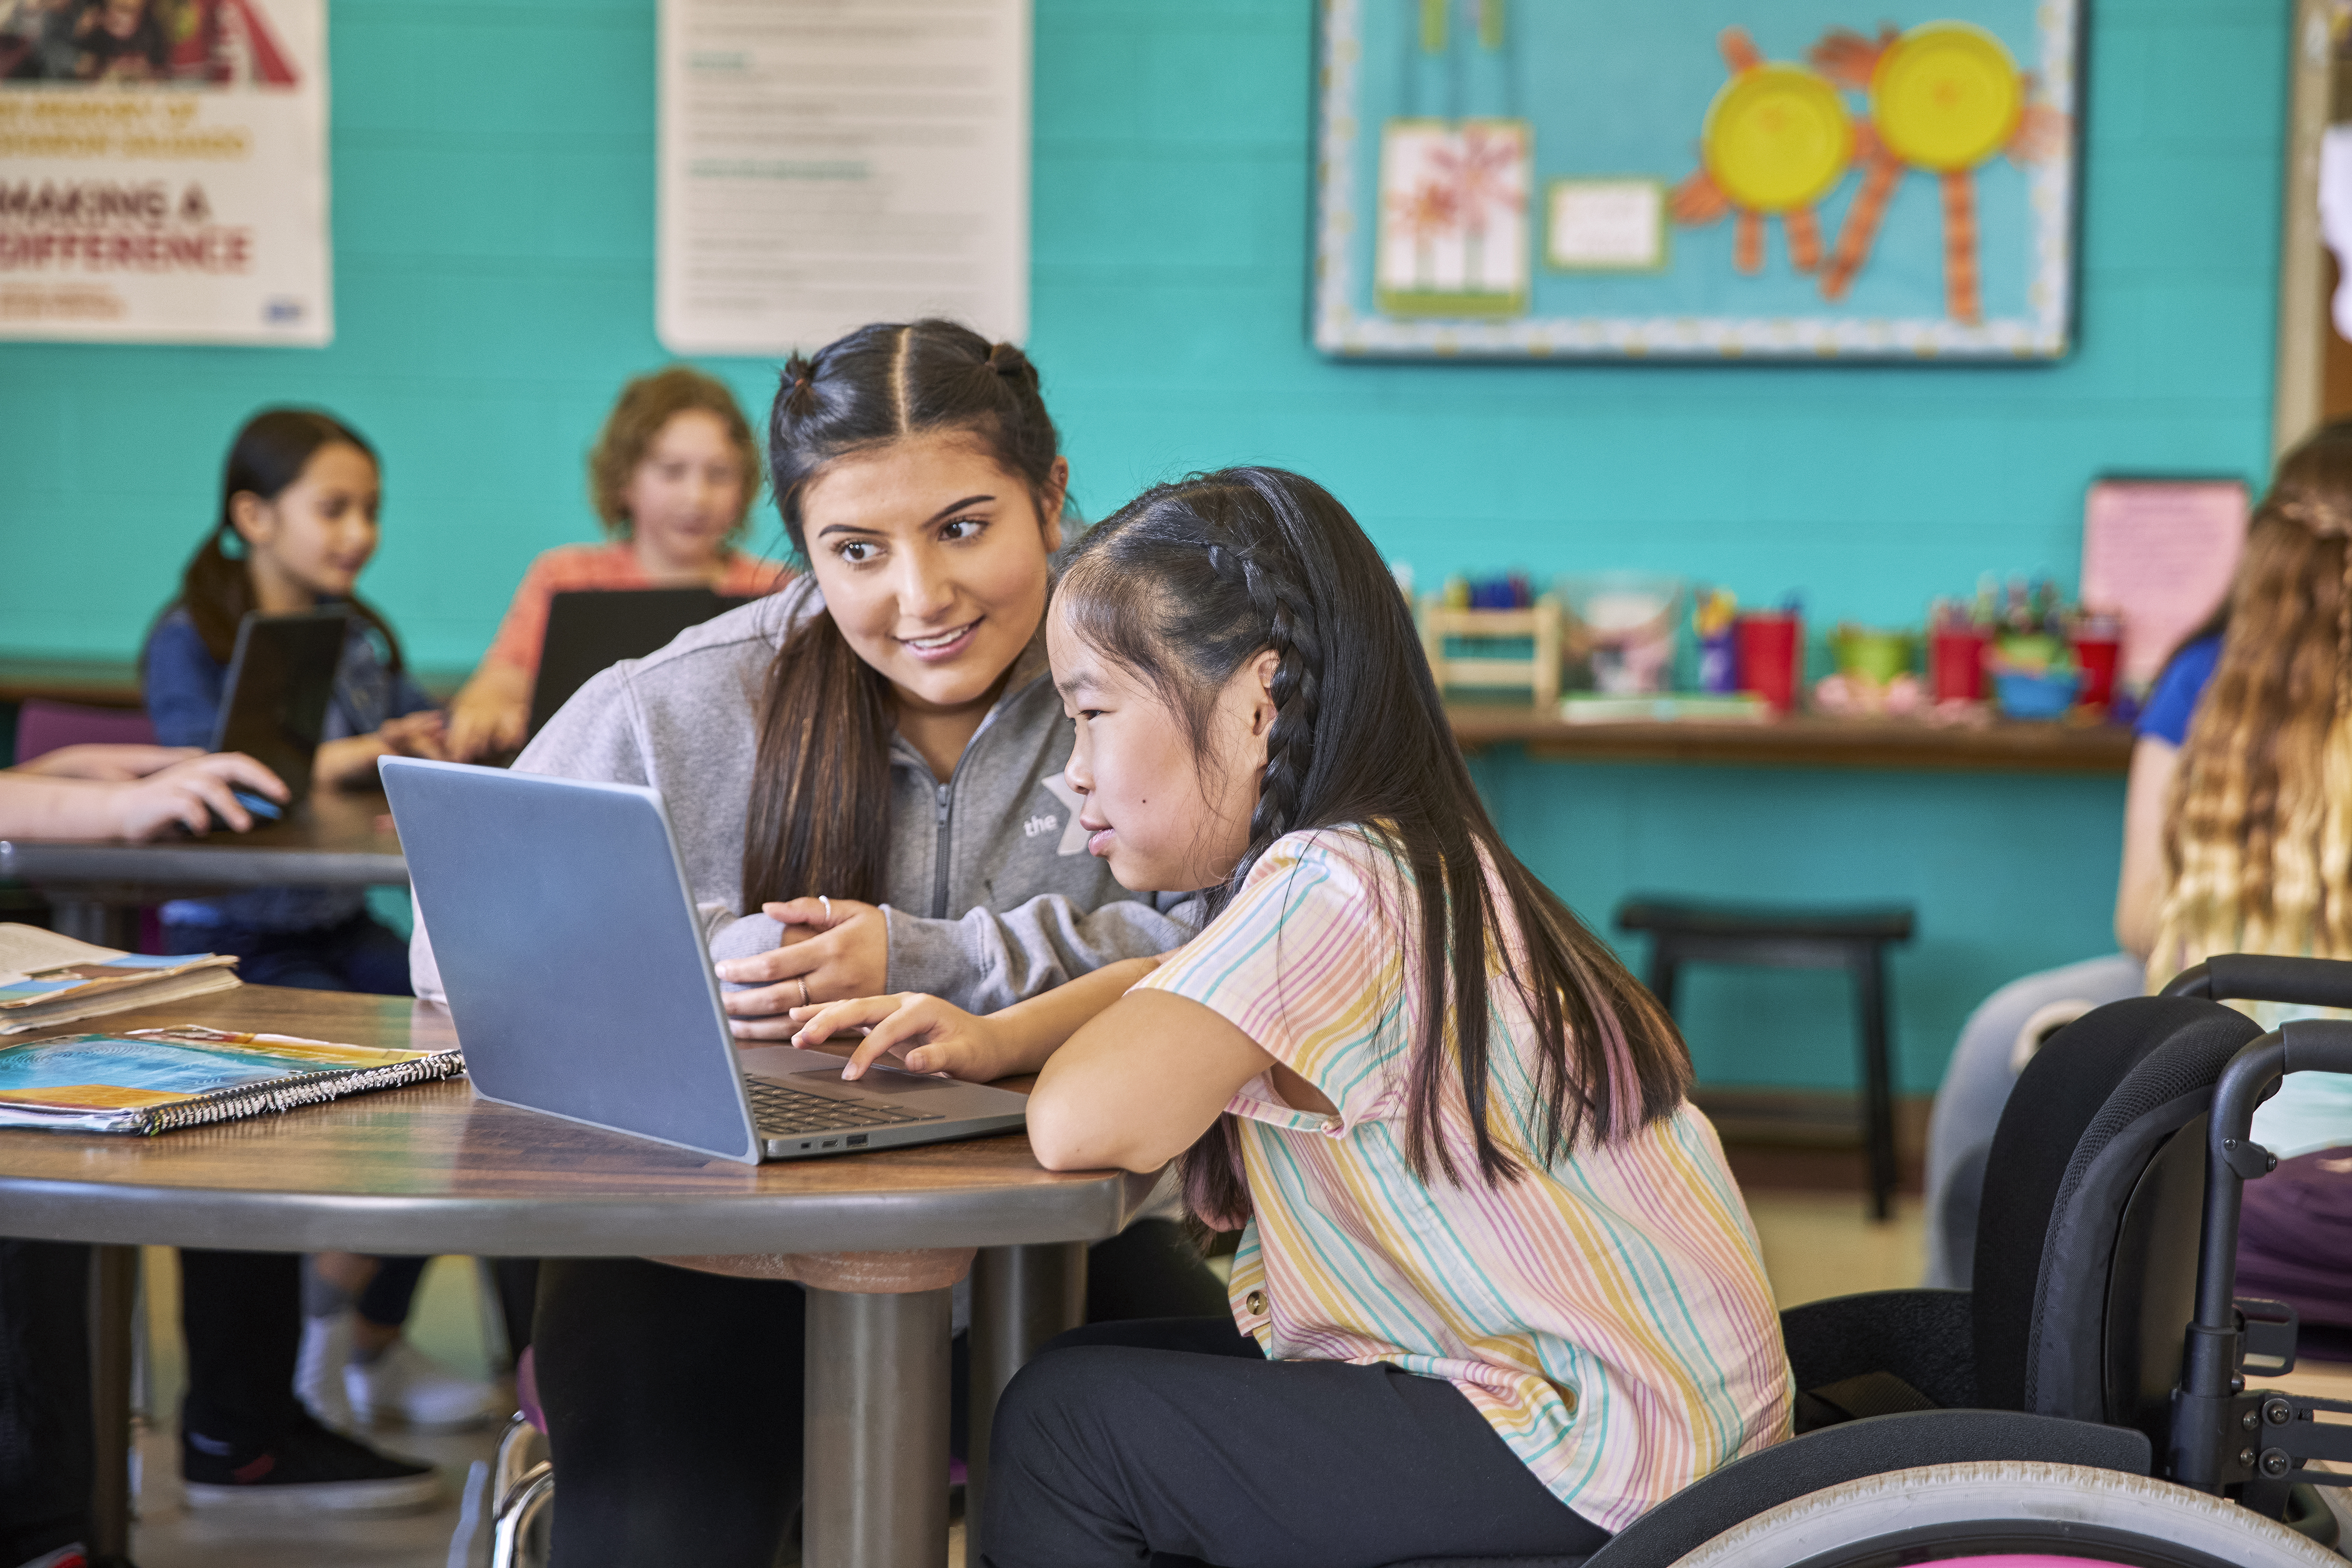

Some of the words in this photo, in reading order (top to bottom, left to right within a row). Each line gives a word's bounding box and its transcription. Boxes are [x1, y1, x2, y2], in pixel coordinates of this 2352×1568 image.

[0, 183, 166, 223] MAKING
[179, 184, 212, 222] A
[0, 230, 252, 269] DIFFERENCE
[1024, 815, 1057, 837] the
